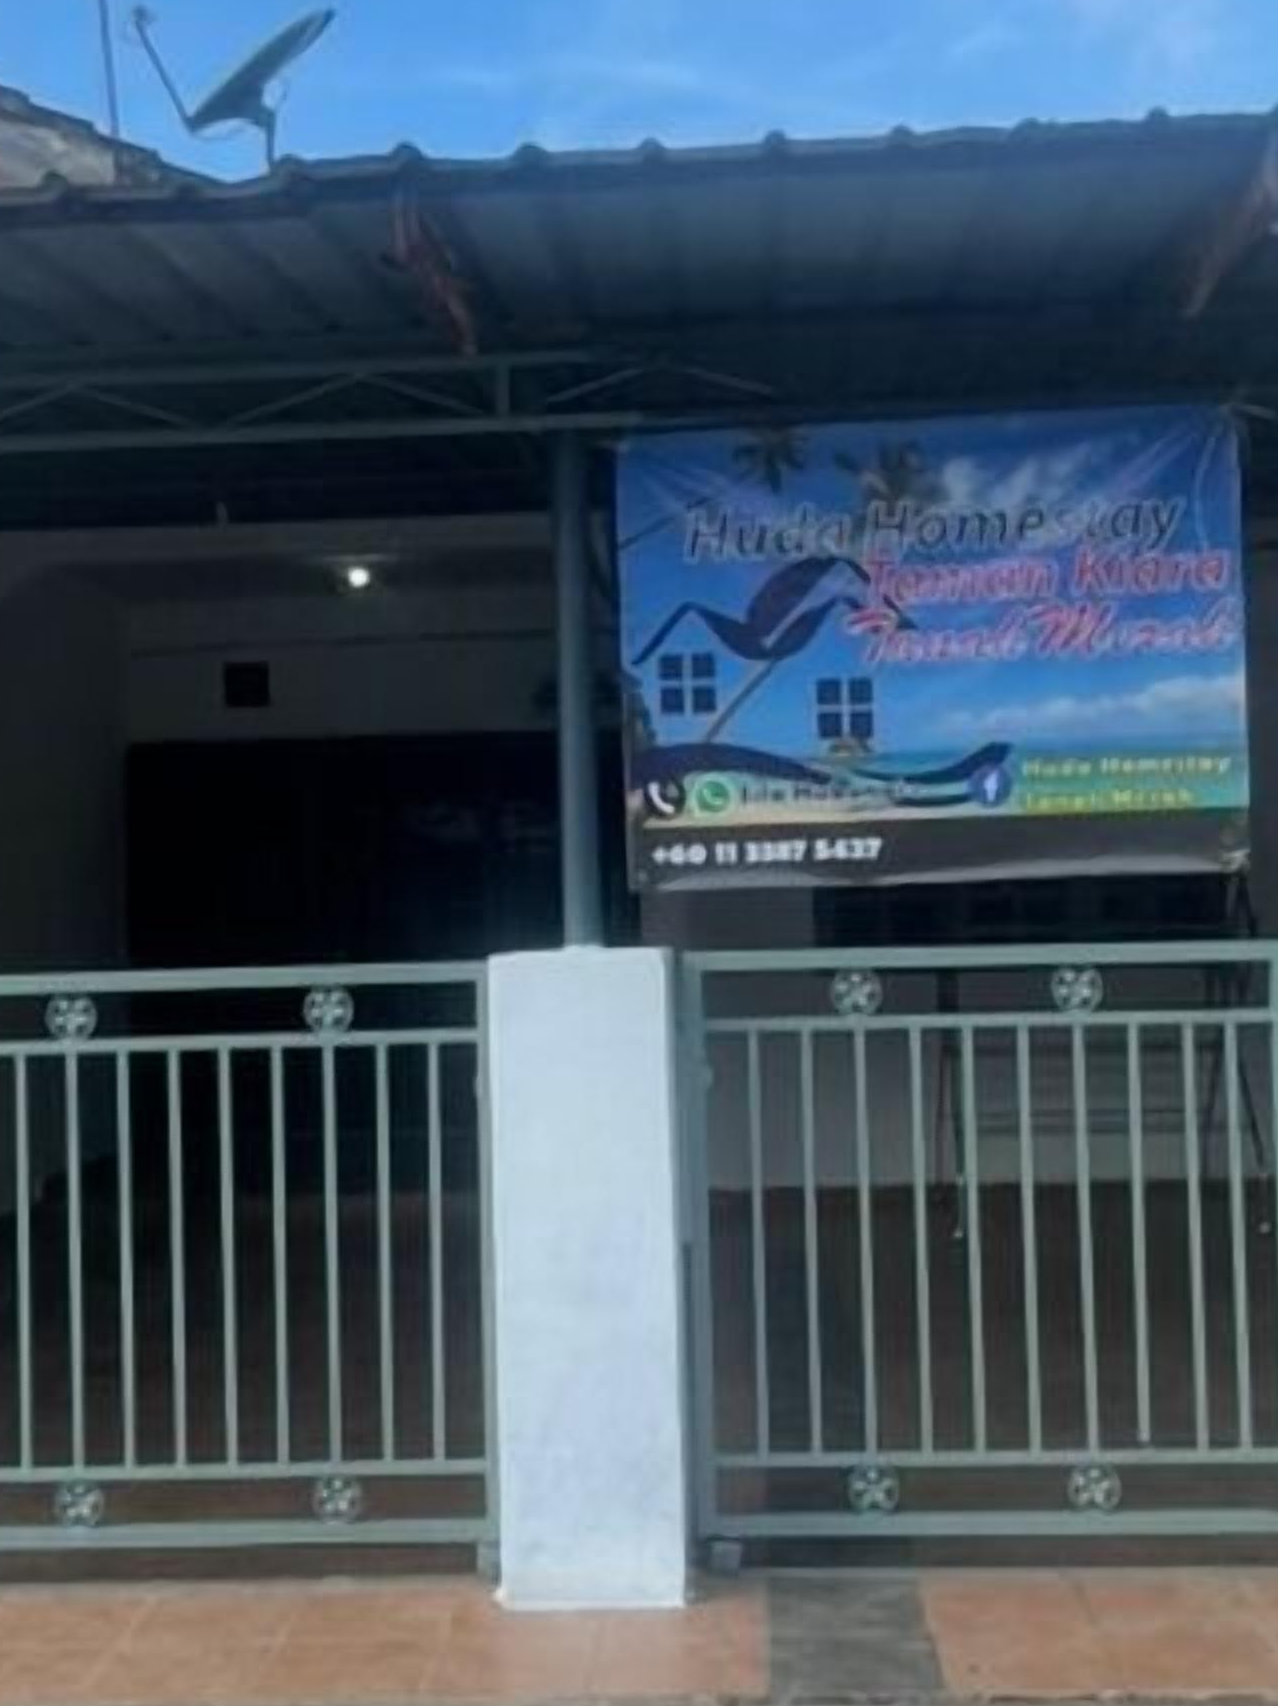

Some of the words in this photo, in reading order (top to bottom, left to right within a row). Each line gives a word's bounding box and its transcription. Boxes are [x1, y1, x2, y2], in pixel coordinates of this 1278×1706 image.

[682, 500, 852, 565] Huda
[862, 496, 1187, 561] Homestay
[864, 551, 1059, 605] Taman
